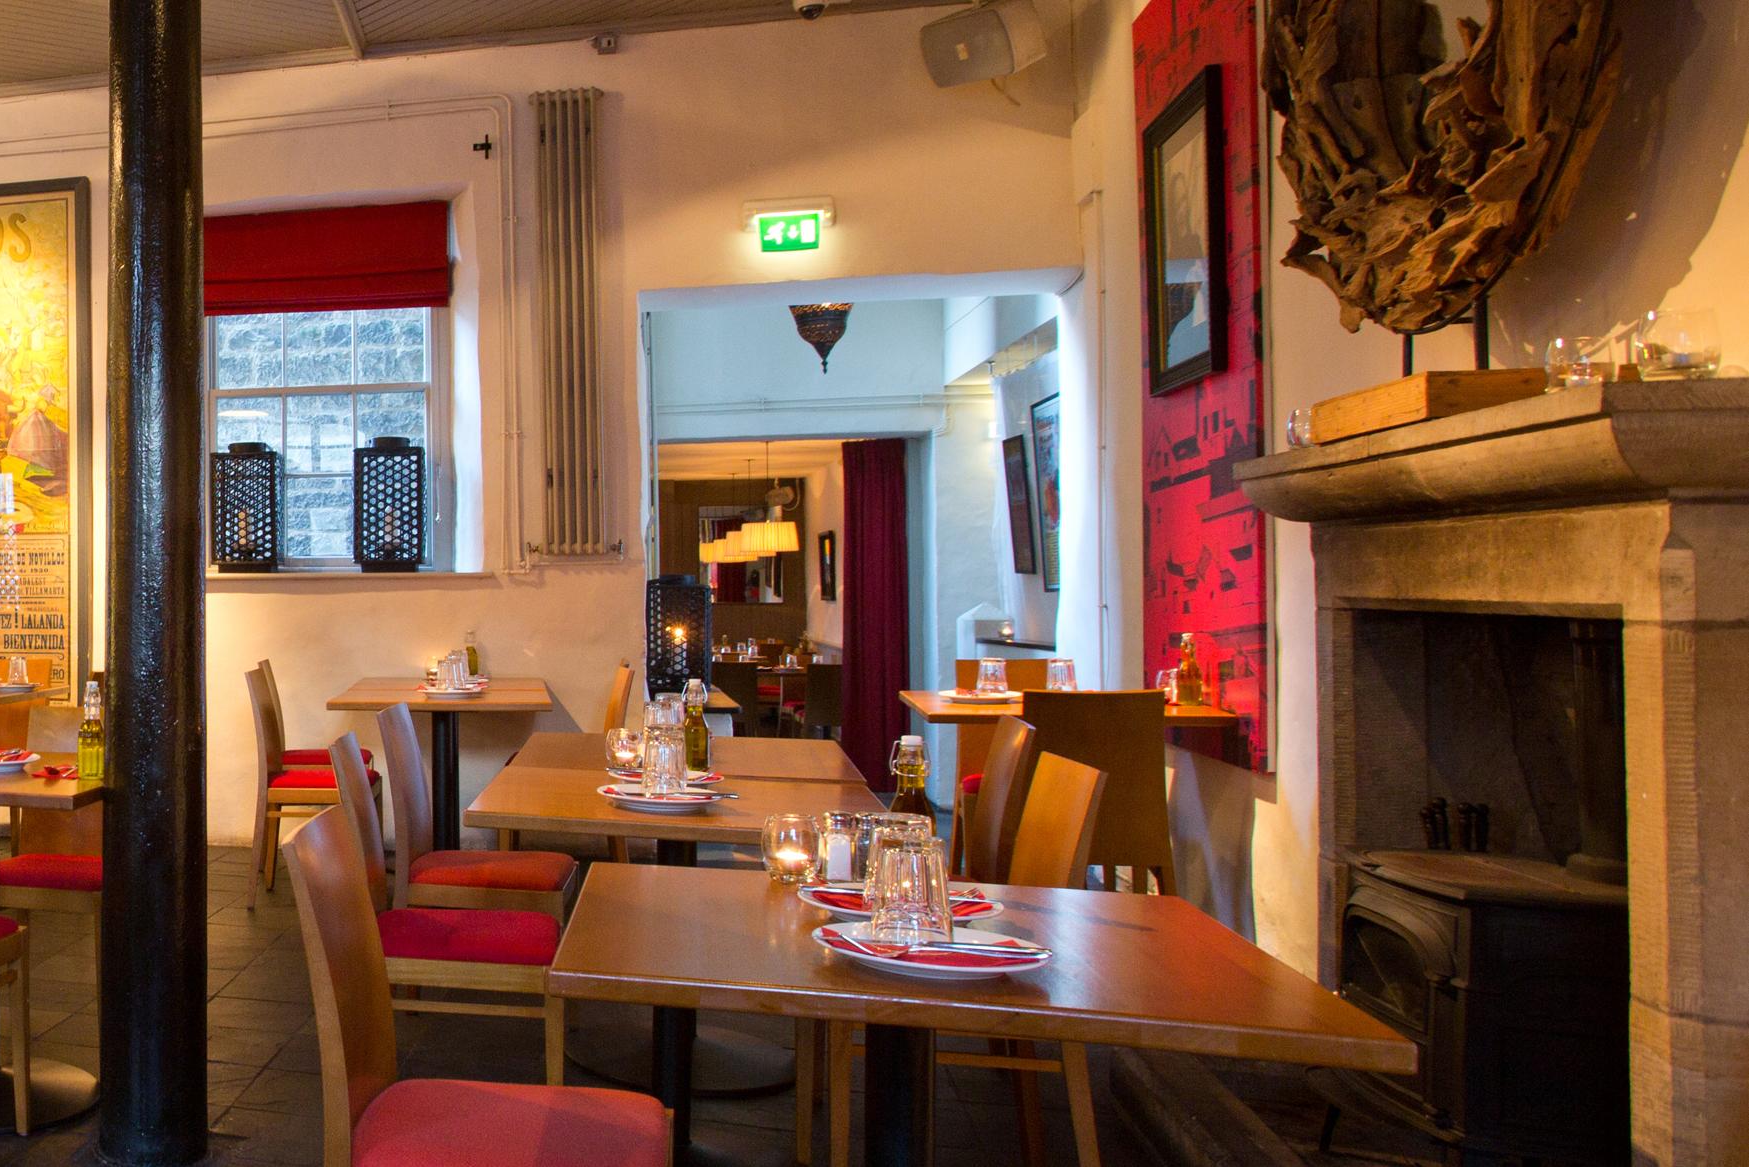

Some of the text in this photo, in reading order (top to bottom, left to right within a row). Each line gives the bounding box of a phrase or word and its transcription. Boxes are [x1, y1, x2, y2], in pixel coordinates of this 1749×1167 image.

[28, 552, 65, 566] NOVILLOS
[21, 613, 65, 630] LALANDA
[3, 633, 65, 650] BIENVENIDA
